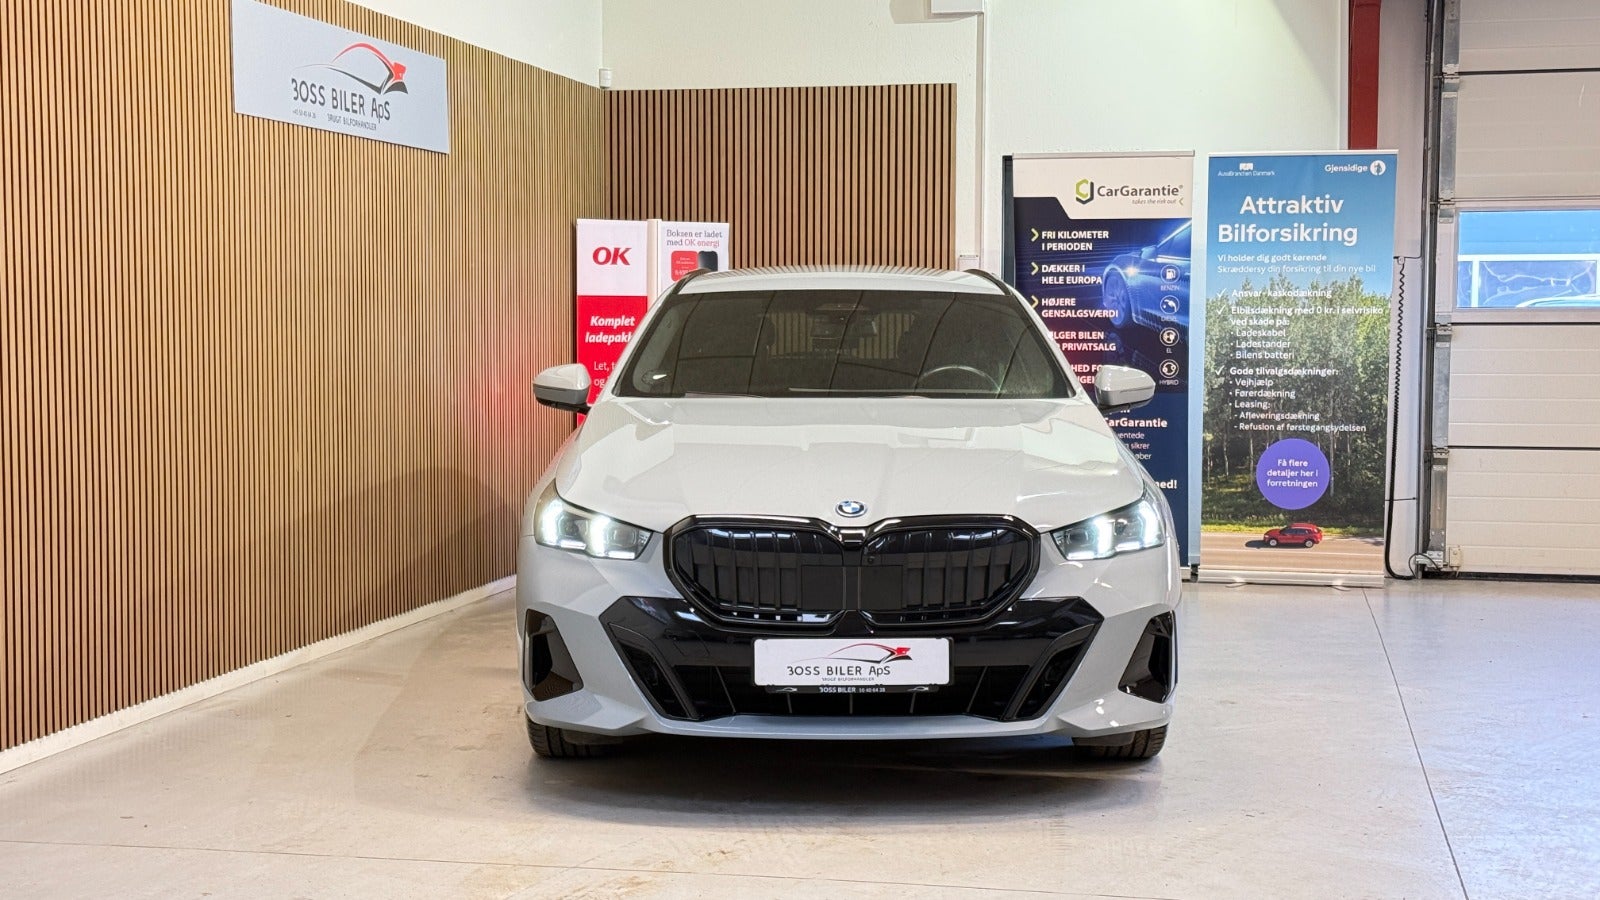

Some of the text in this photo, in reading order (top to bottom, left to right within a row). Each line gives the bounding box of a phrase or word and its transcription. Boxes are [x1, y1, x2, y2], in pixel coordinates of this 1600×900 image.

[331, 88, 365, 116] BILER
[371, 99, 391, 124] ApS
[1324, 164, 1368, 173] Gjensidige
[1239, 194, 1344, 215] Attraktiv
[666, 229, 693, 238] Boksen
[704, 229, 723, 238] ladet
[1042, 230, 1109, 240] FRI KILOMETER
[1218, 222, 1358, 246] Bilforsikring
[666, 238, 720, 248] med OK energi
[1047, 243, 1093, 251] PERIODEN
[592, 246, 633, 265] OK
[1218, 254, 1327, 263] Vi holder dig godt kørende
[1042, 265, 1080, 273] DÆKKER
[1217, 264, 1376, 274] Skræddersy din forsikring til din nye bil
[1042, 276, 1102, 285] HELE EUROPA
[1267, 288, 1332, 298] kaskodækning
[1041, 298, 1076, 306] HØJERE
[1041, 310, 1119, 318] GENSALGSVÆRDI
[1231, 306, 1293, 316] Elbilsdækning
[1294, 306, 1315, 314] med
[1316, 306, 1322, 314] 0
[1324, 306, 1335, 314] kr.
[1341, 306, 1383, 314] selvrisiko
[590, 316, 635, 329] Komplet
[1230, 318, 1290, 327] ved skade på:
[1078, 331, 1104, 340] BILEN
[1236, 329, 1287, 337] Ladeskabel
[1062, 342, 1116, 351] PRIVATSALG
[1236, 340, 1291, 348] Ladestander
[1235, 351, 1295, 359] Bilens batteri
[593, 361, 610, 372] Let,
[1229, 366, 1339, 376] Gode tilvalgsdækninger:
[594, 378, 605, 389] og
[1235, 379, 1274, 387] Vejhjælp
[1234, 389, 1296, 398] Førerdækning
[1234, 401, 1271, 410] Leasing:
[1239, 411, 1320, 421] Afleveringsdækning
[1239, 423, 1275, 431] Refusion
[1276, 423, 1285, 431] af
[1277, 459, 1309, 467] Få flere
[1266, 469, 1300, 479] detaljer
[1300, 469, 1314, 477] her
[1266, 479, 1318, 489] forretningen
[826, 666, 862, 676] BILER
[868, 665, 891, 678] ApS
